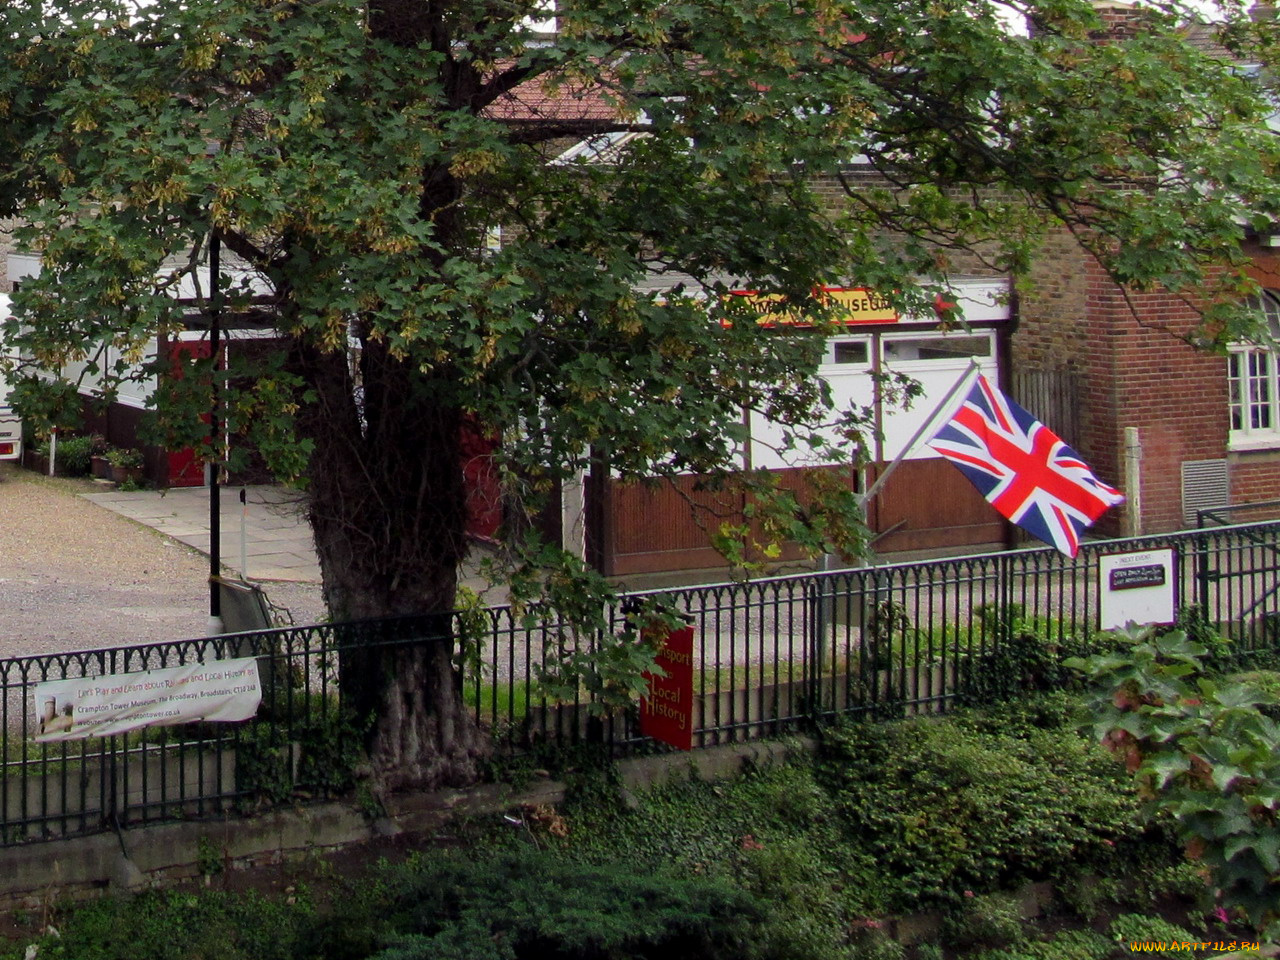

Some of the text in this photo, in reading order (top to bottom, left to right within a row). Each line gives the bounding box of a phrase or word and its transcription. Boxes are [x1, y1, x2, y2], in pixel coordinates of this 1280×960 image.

[96, 687, 110, 697] Play
[111, 686, 122, 694] and
[124, 683, 143, 693] Learn
[144, 681, 165, 690] about
[190, 673, 203, 682] and
[205, 672, 222, 681] Local
[224, 669, 246, 679] History
[651, 675, 680, 704] Local
[77, 703, 110, 714] Crampton
[111, 702, 130, 710] Tower
[646, 696, 686, 729] History
